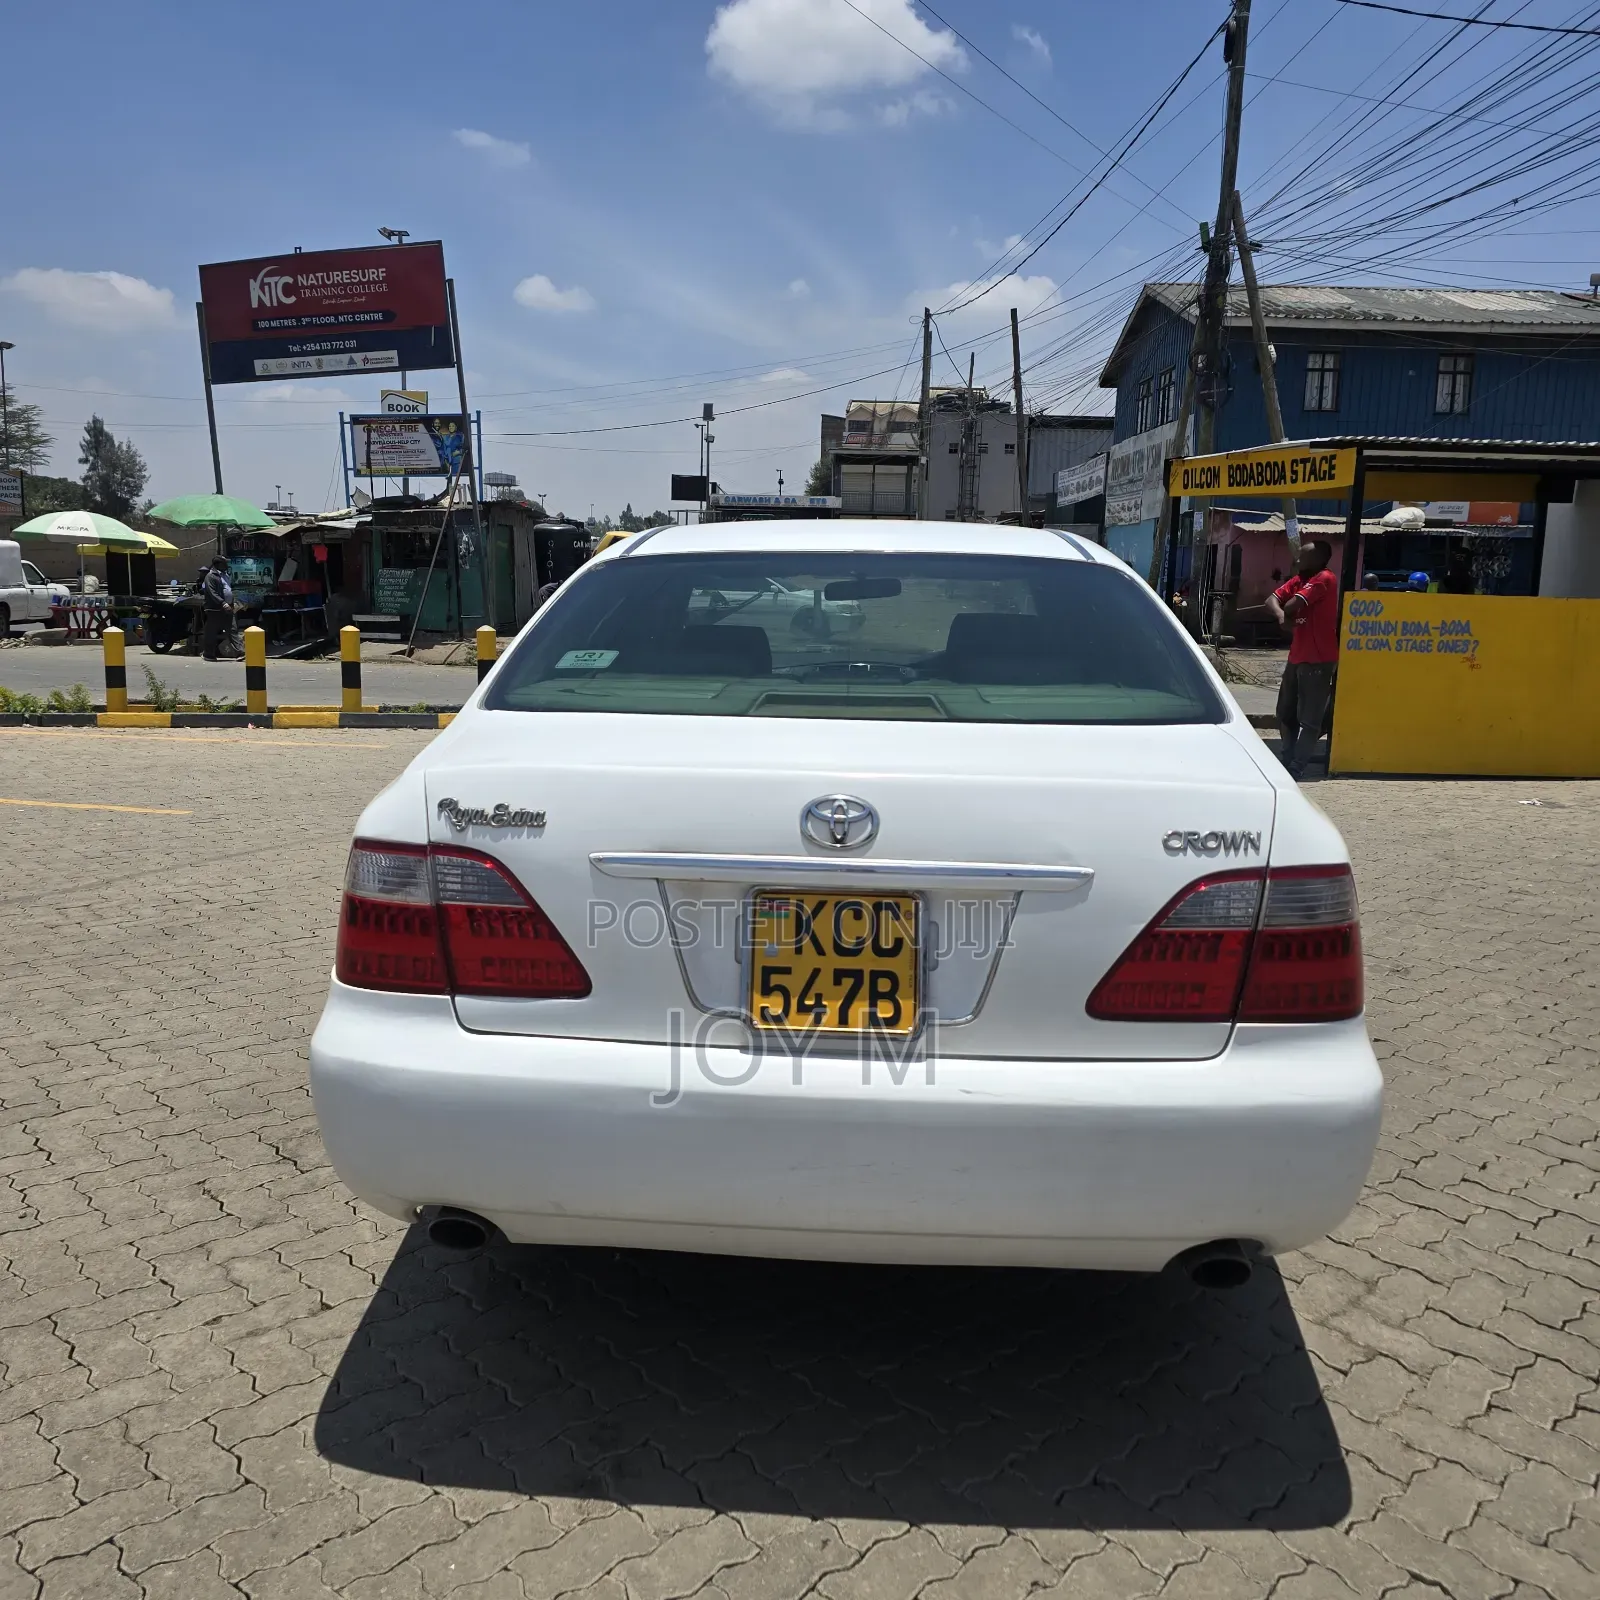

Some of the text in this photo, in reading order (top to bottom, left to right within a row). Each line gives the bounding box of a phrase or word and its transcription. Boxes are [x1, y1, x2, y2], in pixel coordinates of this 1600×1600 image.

[250, 266, 387, 308] NTC NATURESURF
[300, 283, 388, 298] TRAINING COLLEGE
[258, 320, 270, 328] 100
[271, 318, 297, 328] METRES
[313, 315, 337, 325] FLOOR,
[339, 314, 354, 323] NTC
[355, 312, 383, 322] CENTRE
[288, 340, 357, 352] Tel: +254 113 772 031
[387, 403, 420, 413] BOOK
[399, 424, 420, 433] FIRE
[1183, 454, 1337, 490] OILCOM BODABODA STAGE
[1349, 598, 1384, 618] GOOD
[1348, 620, 1398, 637] USHINDI
[1365, 638, 1391, 651] COM
[1394, 638, 1433, 653] STAGE
[1162, 829, 1262, 852] CROWN
[794, 899, 904, 958] KCC
[759, 965, 902, 1027] 547B
